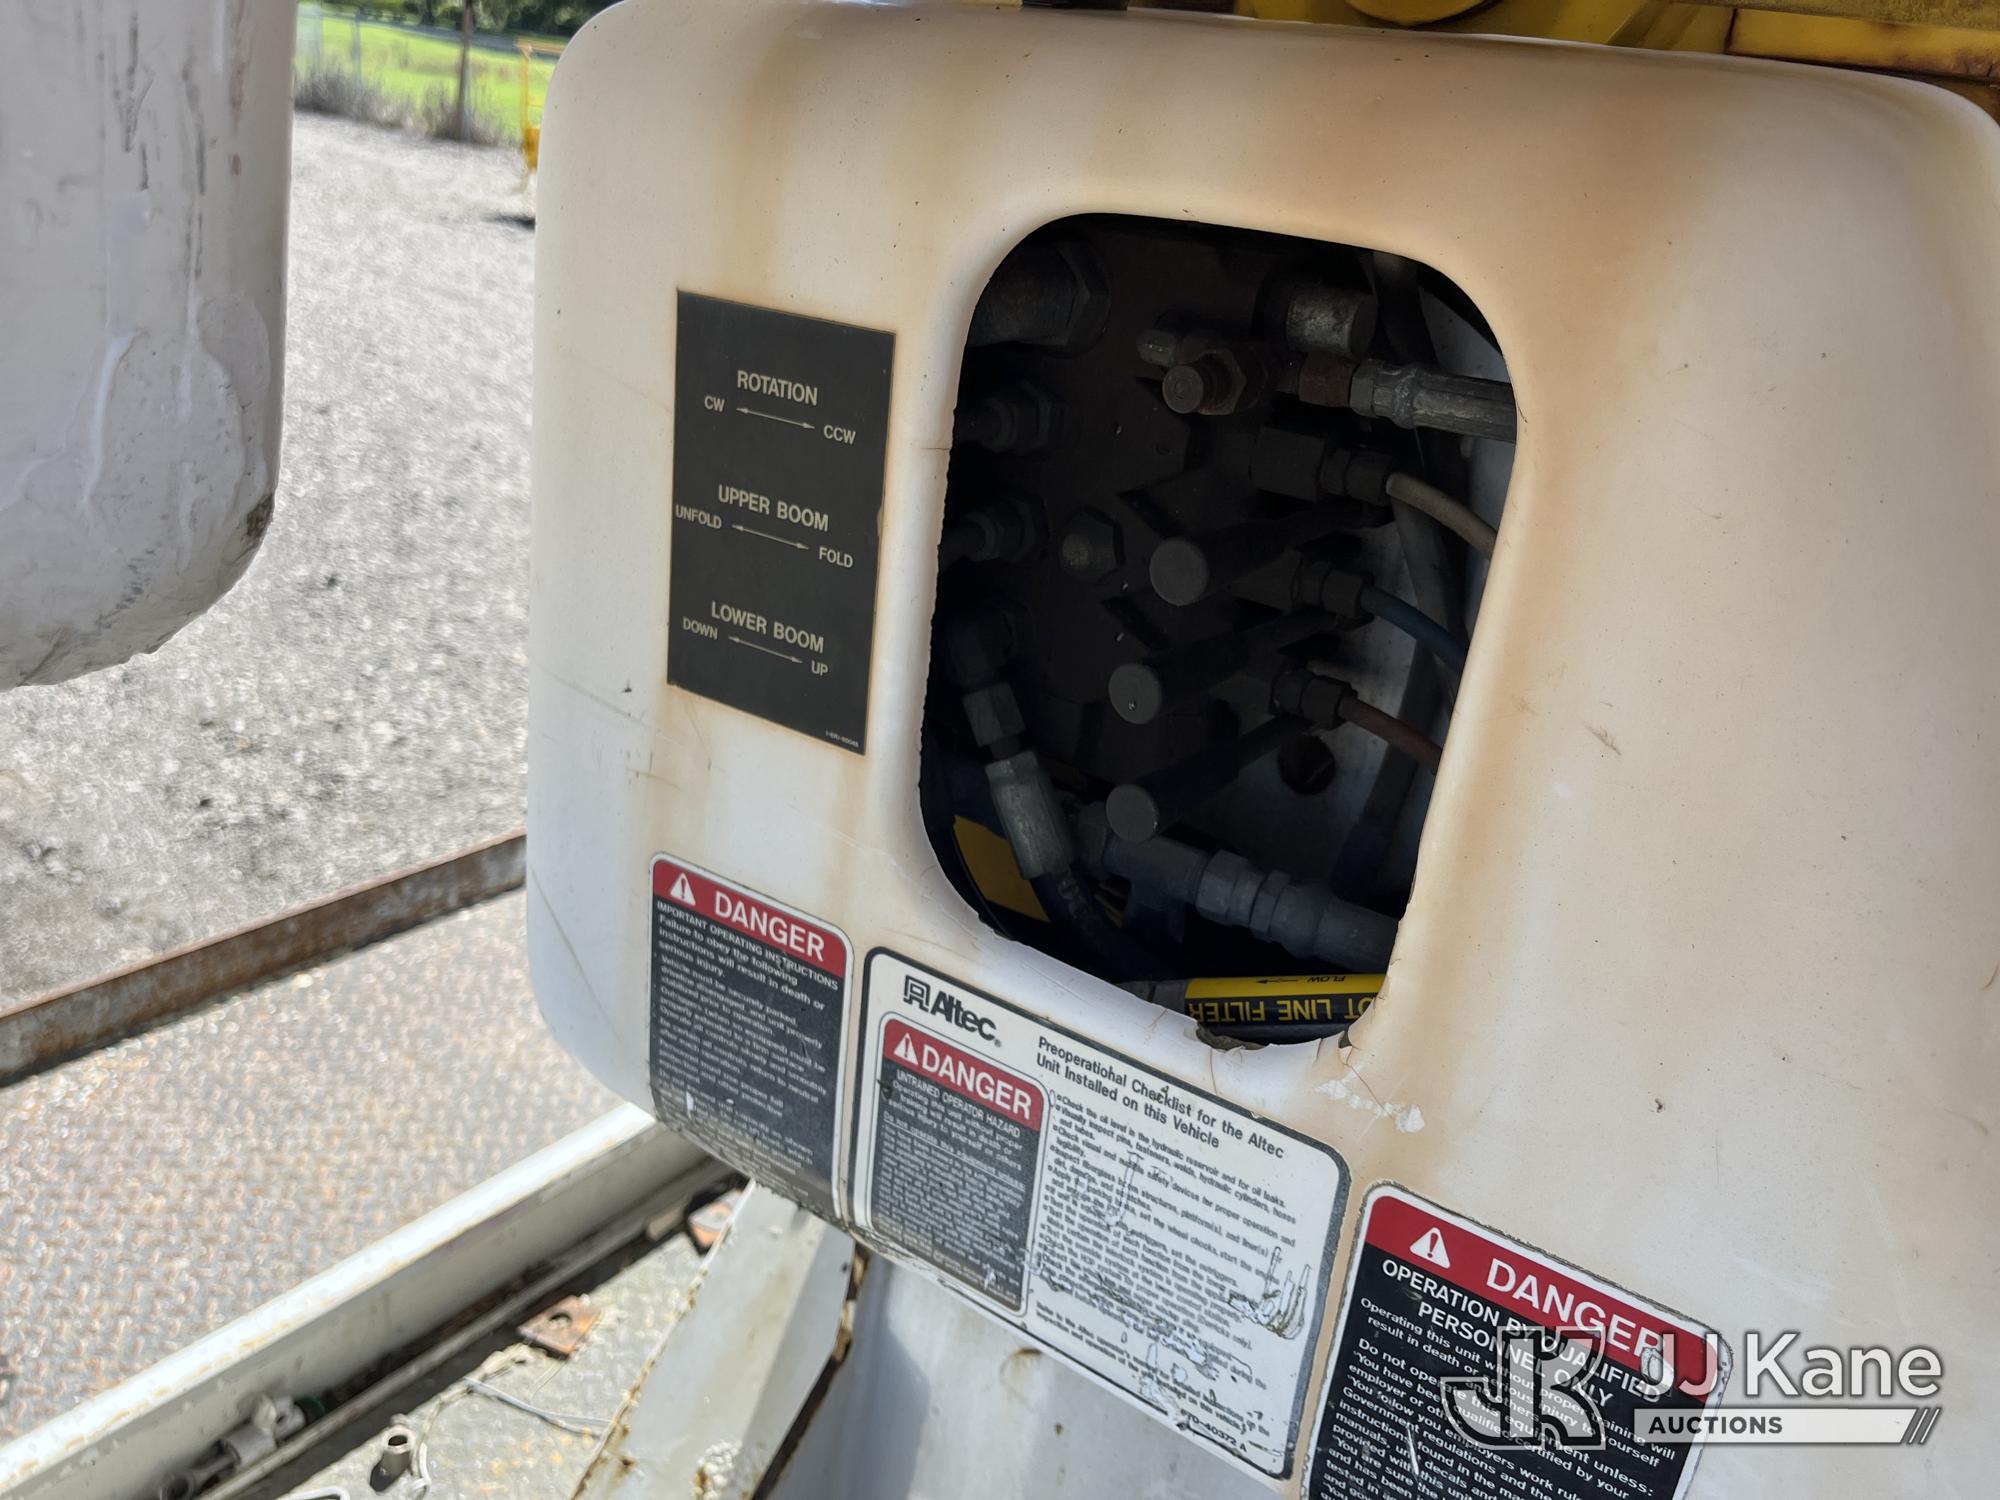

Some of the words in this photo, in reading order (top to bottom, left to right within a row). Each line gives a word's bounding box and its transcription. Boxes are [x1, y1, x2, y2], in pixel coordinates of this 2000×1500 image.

[704, 396, 724, 412] CW
[823, 424, 855, 445] CCW
[737, 370, 818, 405] ROTATION
[675, 505, 721, 529] UNFOLD
[818, 547, 853, 569] FOLD
[718, 484, 770, 514] UPPER
[777, 501, 829, 531] BOOM
[683, 617, 717, 640] DOWN
[811, 660, 828, 677] UP
[711, 601, 766, 634] LOWER
[773, 622, 824, 653] BOOM
[657, 900, 705, 930] IMPORTANT
[710, 924, 762, 956] OPERATING
[765, 949, 838, 991] INSTRUCTIONS
[659, 914, 691, 936] Failure
[694, 930, 703, 941] to
[707, 938, 729, 955] obey
[733, 948, 749, 962] the
[751, 956, 797, 987] following
[659, 940, 693, 963] serious
[696, 956, 724, 978] injury.
[715, 891, 824, 962] DANGER
[659, 926, 714, 959] instructions
[718, 955, 734, 969] will
[737, 964, 765, 983] result
[769, 977, 778, 989] in
[781, 983, 810, 1004] death
[813, 1000, 824, 1011] or
[715, 979, 725, 991] be
[728, 987, 762, 1011] securely
[1306, 975, 1346, 983] FLOW
[1189, 1001, 1264, 1023] FILTER
[1277, 999, 1332, 1021] LINE
[892, 1080, 928, 1105] Operating
[930, 1099, 944, 1112] this
[947, 1108, 961, 1120] unit
[965, 1117, 993, 1135] without
[995, 1132, 1022, 1150] proper
[896, 1069, 940, 1098] UNTRAINED
[943, 1092, 983, 1120] OPERATOR
[986, 1113, 1020, 1138] HAZARD
[922, 1045, 1031, 1120] DANGER
[1035, 1053, 1060, 1074] Unit
[1063, 1066, 1118, 1101] Installed
[1121, 1095, 1140, 1112] on
[1143, 1102, 1167, 1125] this
[1171, 1115, 1219, 1149] Vehicle
[1061, 1106, 1086, 1126] Visually
[1088, 1119, 1114, 1138] inspect
[1199, 1172, 1231, 1194] hydraulic
[1062, 1095, 1083, 1111] Check
[1086, 1106, 1096, 1118] the
[1099, 1114, 1108, 1123] oil
[1110, 1118, 1126, 1132] level
[1128, 1127, 1134, 1136] in
[1138, 1131, 1149, 1143] the
[1152, 1138, 1183, 1159] hydraulic
[1221, 1173, 1235, 1184] and
[1238, 1179, 1249, 1191] for
[1252, 1187, 1261, 1196] oil
[1130, 1078, 1192, 1117] Checklist
[1196, 1107, 1216, 1128] for
[1220, 1118, 1243, 1140] the
[1248, 1130, 1284, 1159] Altec
[1381, 1257, 1500, 1327] OPERATION
[1504, 1316, 1537, 1344] BY
[1538, 1332, 1662, 1404] QUALIFIED
[1417, 1301, 1549, 1377] PERSONNEL
[1552, 1367, 1614, 1409] ONLY
[1347, 1365, 1406, 1399] employer
[1408, 1395, 1423, 1408] or
[1360, 1296, 1422, 1337] Operating
[1425, 1329, 1450, 1349] this
[1454, 1345, 1481, 1364] unit
[1483, 1360, 1538, 1392] without
[1538, 1387, 1586, 1416] proper
[1590, 1411, 1646, 1447] training
[1650, 1443, 1676, 1460] will
[1367, 1316, 1404, 1340] result
[1406, 1334, 1419, 1348] in
[1421, 1341, 1460, 1368] death
[1463, 1364, 1478, 1377] or
[1481, 1373, 1534, 1405] serious
[1537, 1399, 1578, 1429] injury
[1580, 1421, 1596, 1436] to
[1600, 1433, 1660, 1467] yourself
[1335, 1413, 1389, 1448] manuals,
[1395, 1445, 1421, 1464] unt
[1423, 1459, 1467, 1489] decals
[1342, 1386, 1420, 1434] Government
[1422, 1430, 1496, 1474] regulations
[1499, 1471, 1526, 1489] and
[1352, 1378, 1372, 1396] You
[1416, 1414, 1441, 1432] you
[1444, 1428, 1515, 1470] employers
[1519, 1467, 1554, 1490] work
[1357, 1353, 1379, 1372] You
[1382, 1366, 1413, 1389] have
[1415, 1383, 1447, 1407] been
[1575, 1465, 1592, 1482] by
[1593, 1476, 1629, 1499] your
[1358, 1337, 1378, 1356] Do
[1381, 1352, 1406, 1370] not
[1408, 1365, 1466, 1401] operate
[1470, 1395, 1499, 1417] this
[1503, 1414, 1591, 1464] equipment
[1593, 1460, 1654, 1496] unless:
[1324, 1473, 1346, 1489] and
[1325, 1459, 1364, 1486] tested
[1367, 1481, 1379, 1494] in
[1328, 1448, 1351, 1465] and
[1354, 1460, 1377, 1479] has
[1380, 1475, 1412, 1498] been
[1332, 1425, 1385, 1458] provided
[1420, 1470, 1443, 1489] this
[1338, 1439, 1357, 1456] You
[1361, 1453, 1381, 1468] are
[1384, 1465, 1414, 1485] sure
[1417, 1481, 1438, 1498] the
[1416, 1440, 1454, 1468] found
[1457, 1462, 1470, 1477] in
[1472, 1471, 1495, 1490] the
